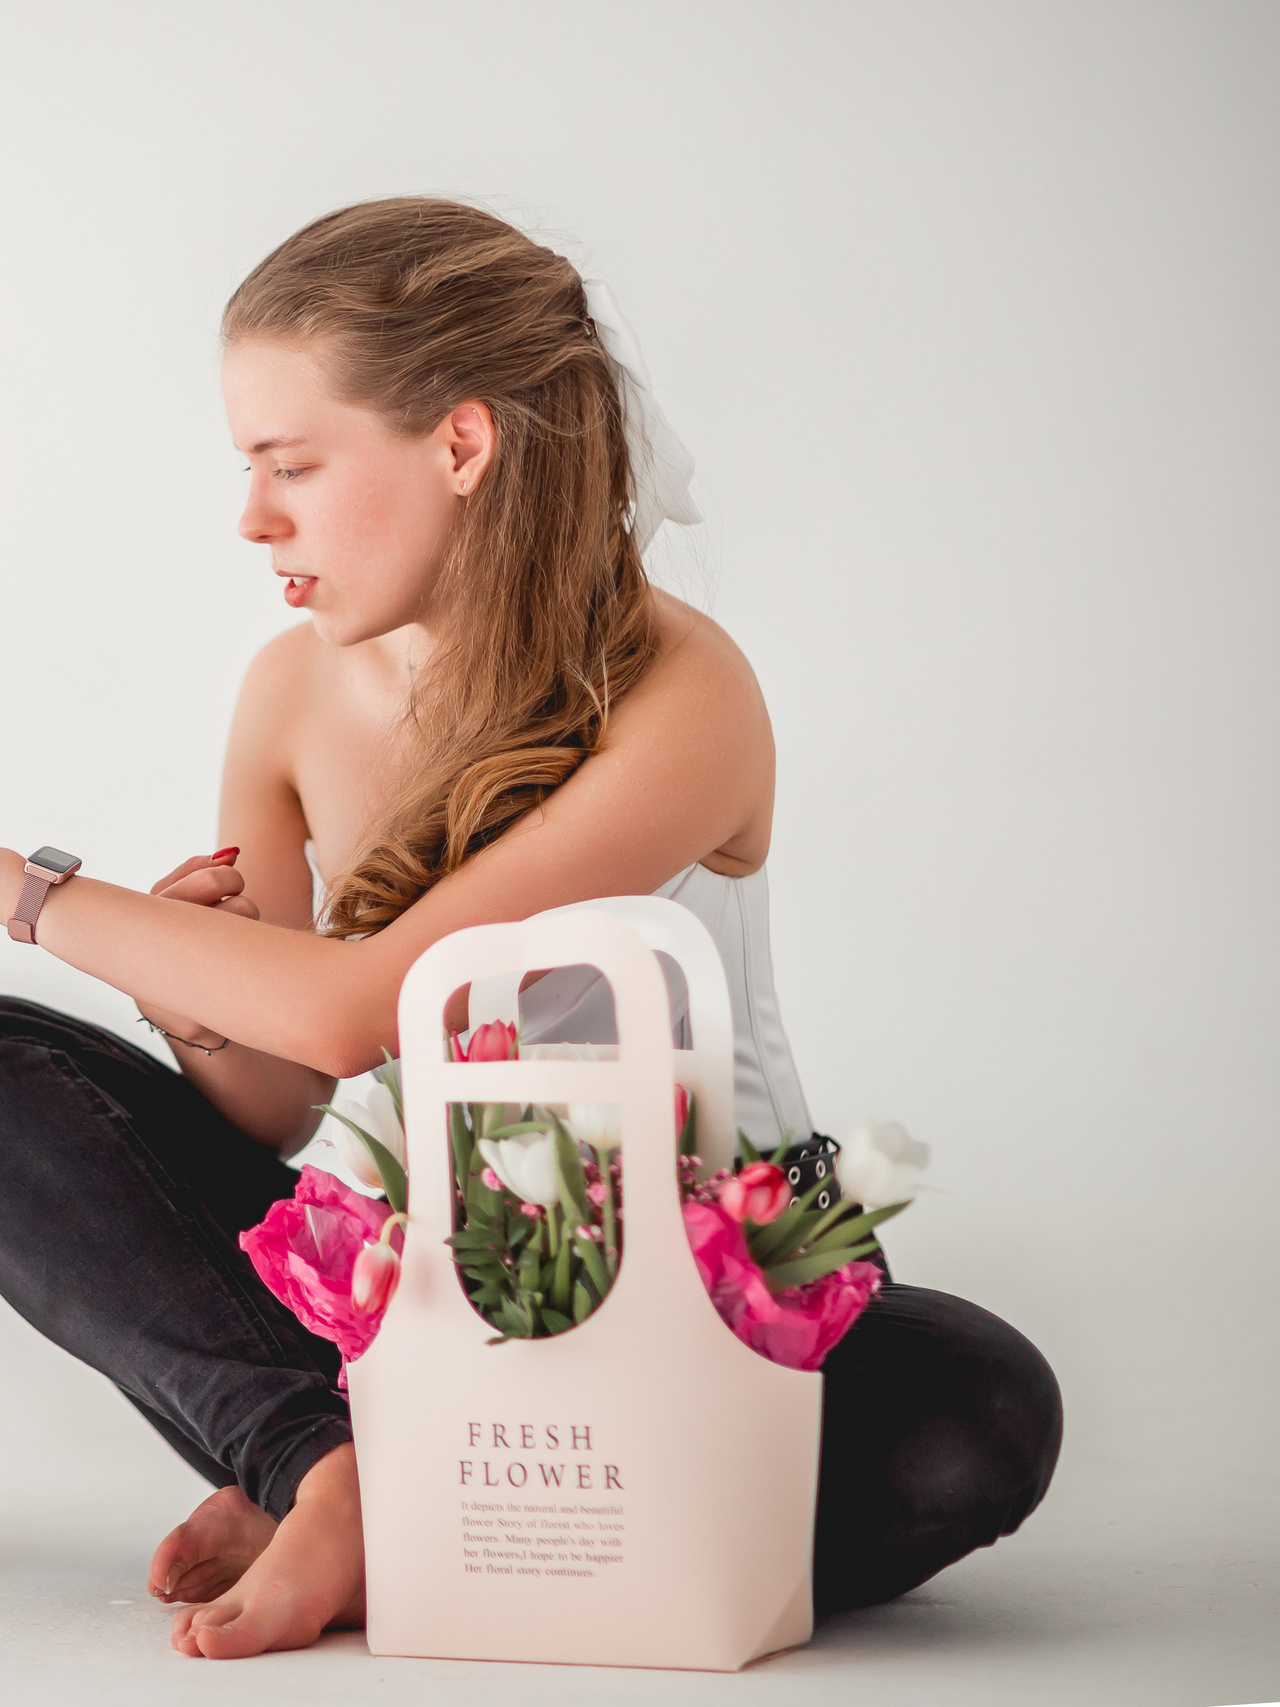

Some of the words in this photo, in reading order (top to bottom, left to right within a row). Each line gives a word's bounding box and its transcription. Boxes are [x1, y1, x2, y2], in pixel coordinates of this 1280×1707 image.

[467, 1422, 594, 1450] FRESH
[458, 1460, 626, 1490] FLOWER
[461, 1500, 469, 1511] It
[470, 1501, 504, 1513] depicts
[507, 1502, 521, 1512] the
[523, 1503, 557, 1513] natural
[560, 1504, 577, 1514] and
[580, 1504, 624, 1515] beautiful
[462, 1516, 493, 1527] flower
[497, 1518, 522, 1530] Story
[526, 1519, 538, 1528] of
[540, 1519, 570, 1529] florist
[574, 1521, 595, 1530] who
[599, 1521, 624, 1531] loves
[462, 1532, 502, 1543] flowers.
[505, 1534, 532, 1546] Many
[536, 1535, 576, 1548] people's
[579, 1537, 596, 1549] day
[600, 1537, 623, 1547] with
[463, 1548, 478, 1557] her
[530, 1550, 554, 1563] hope
[558, 1552, 568, 1560] to
[570, 1552, 582, 1561] be
[585, 1552, 624, 1565] happier
[464, 1563, 482, 1573] Her
[486, 1564, 513, 1574] floral
[516, 1567, 541, 1577] story
